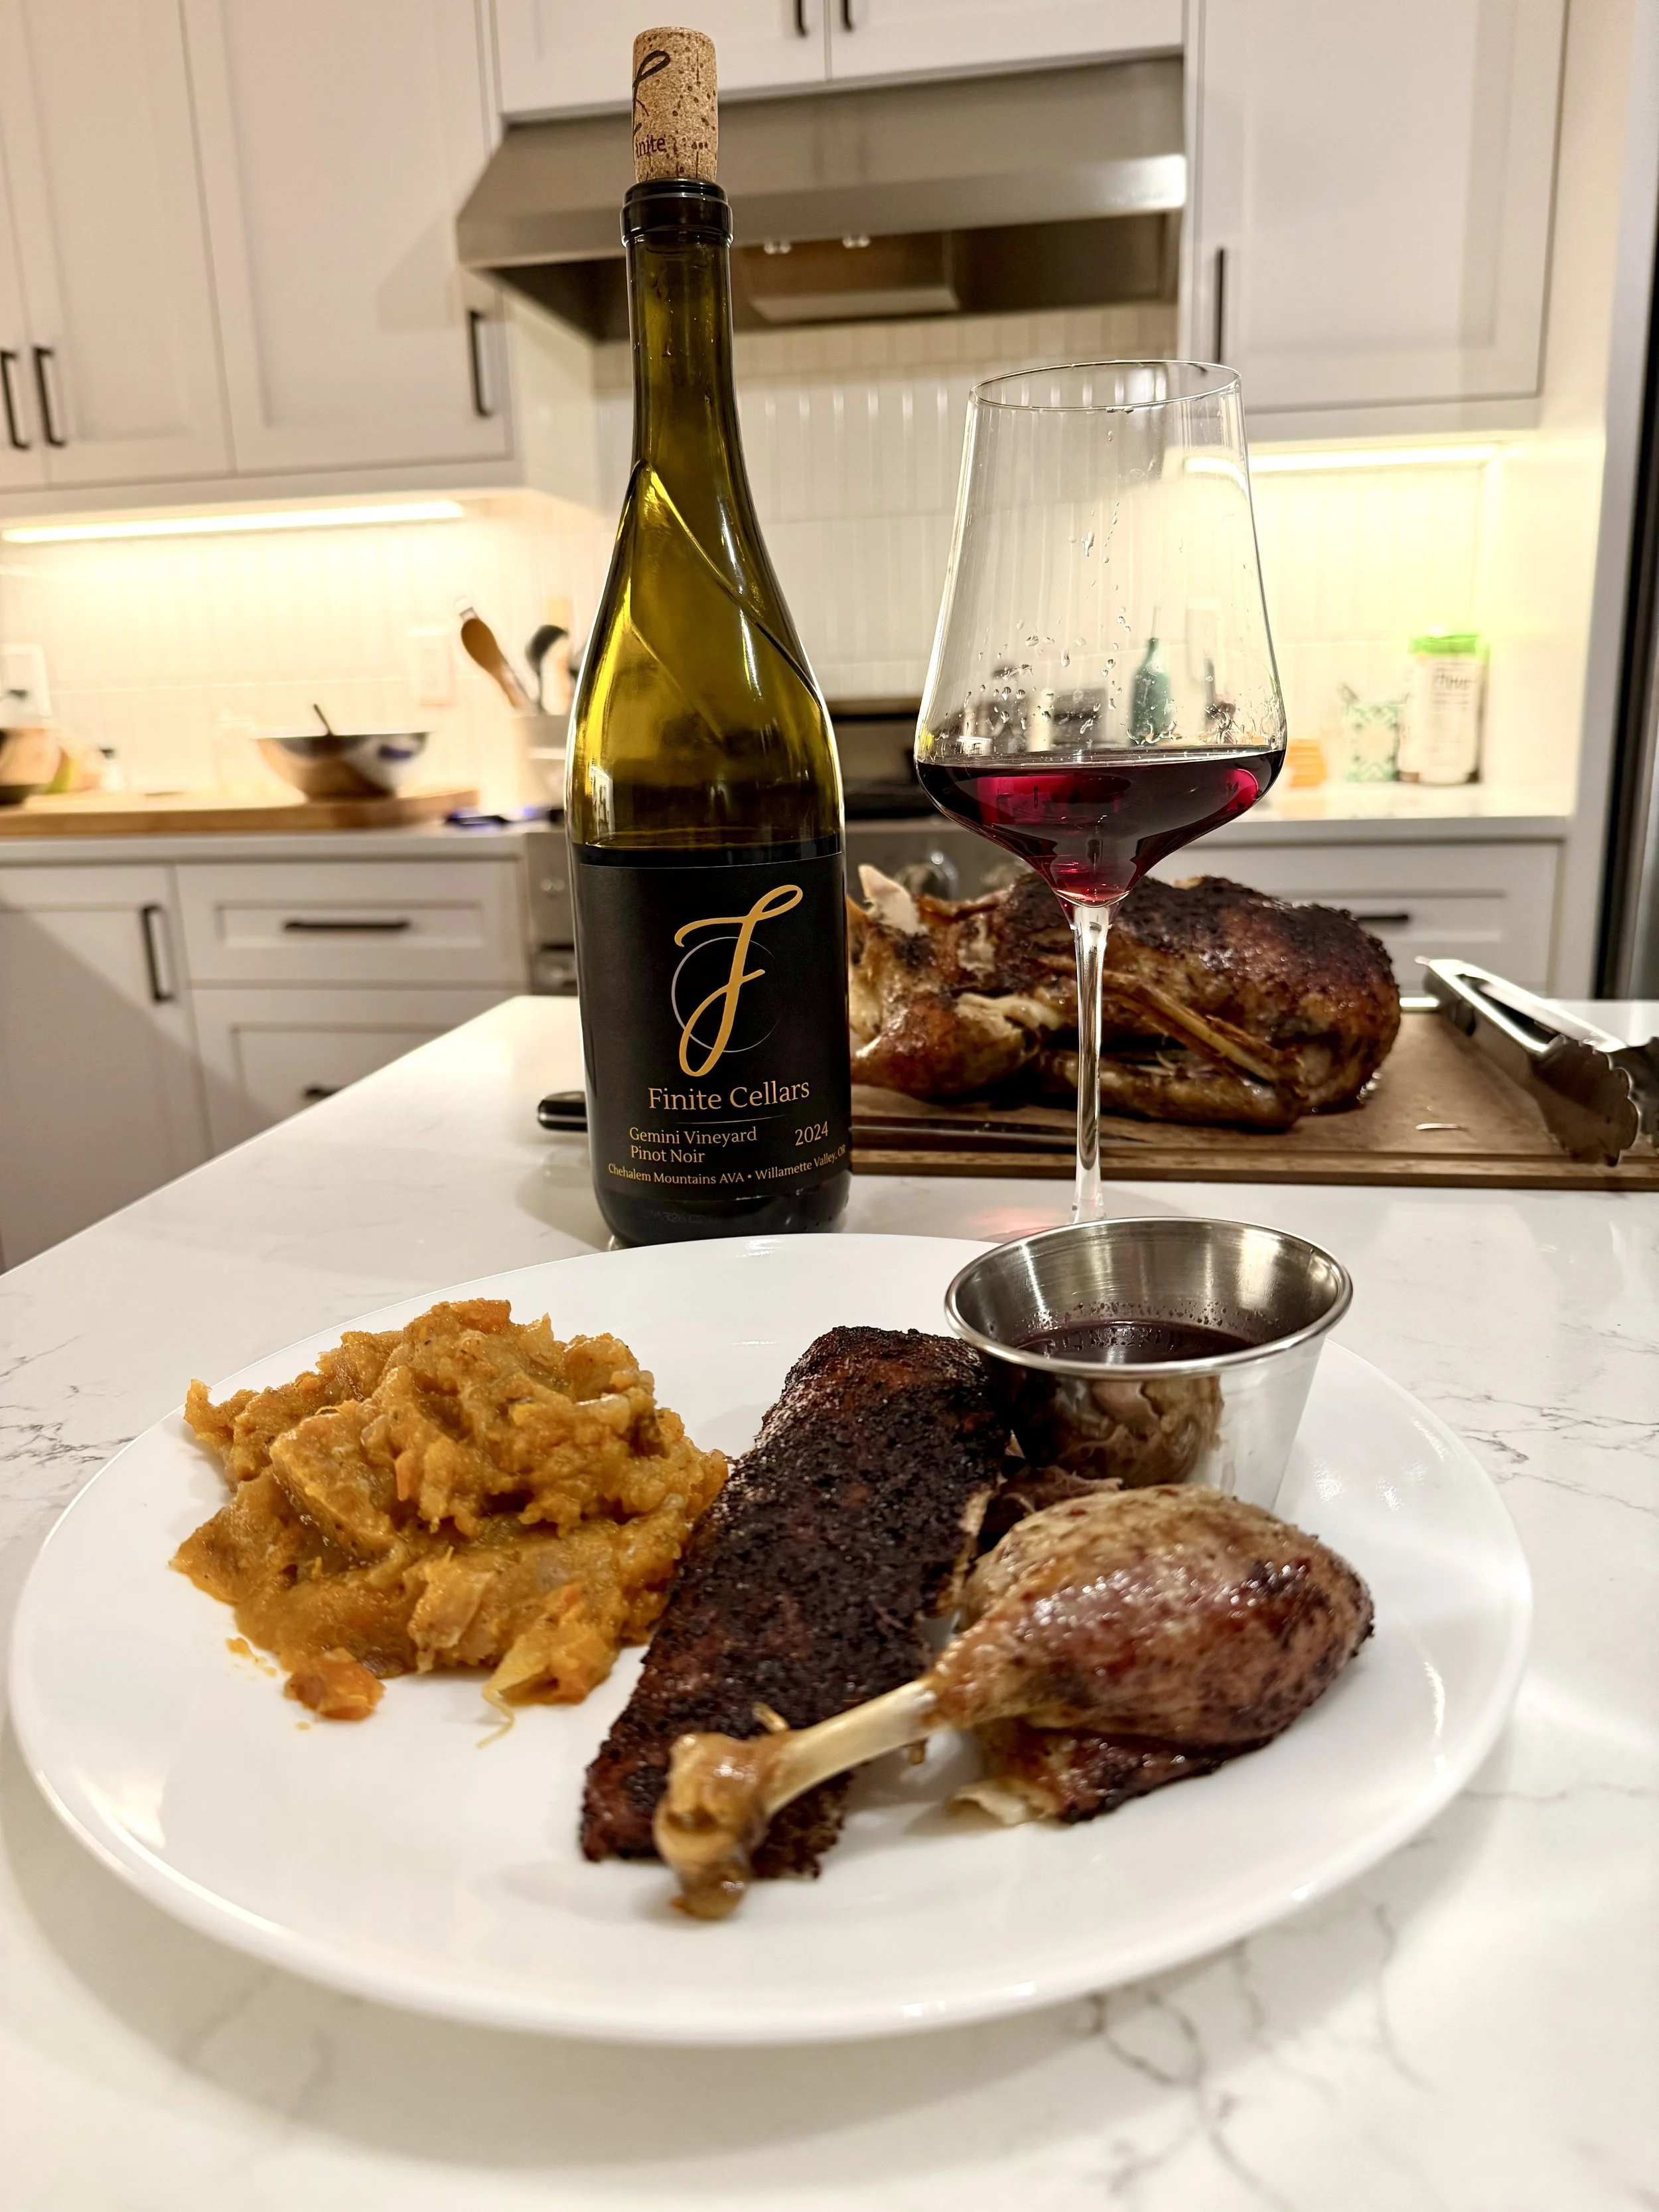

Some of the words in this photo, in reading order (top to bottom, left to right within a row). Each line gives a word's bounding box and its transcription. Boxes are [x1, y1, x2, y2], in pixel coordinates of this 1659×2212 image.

[648, 1087, 722, 1110] Finite
[729, 1080, 810, 1108] Cellars
[629, 1127, 680, 1144] Gemini
[684, 1126, 758, 1147] Vineyard
[794, 1120, 829, 1146] 2024
[608, 1163, 651, 1182] Chehalem
[654, 1172, 717, 1185] Mountains
[719, 1172, 745, 1184] AVA
[755, 1162, 812, 1181] Willamette
[837, 1144, 846, 1157] OR
[630, 1145, 668, 1162] Pinot
[670, 1149, 705, 1163] Noir
